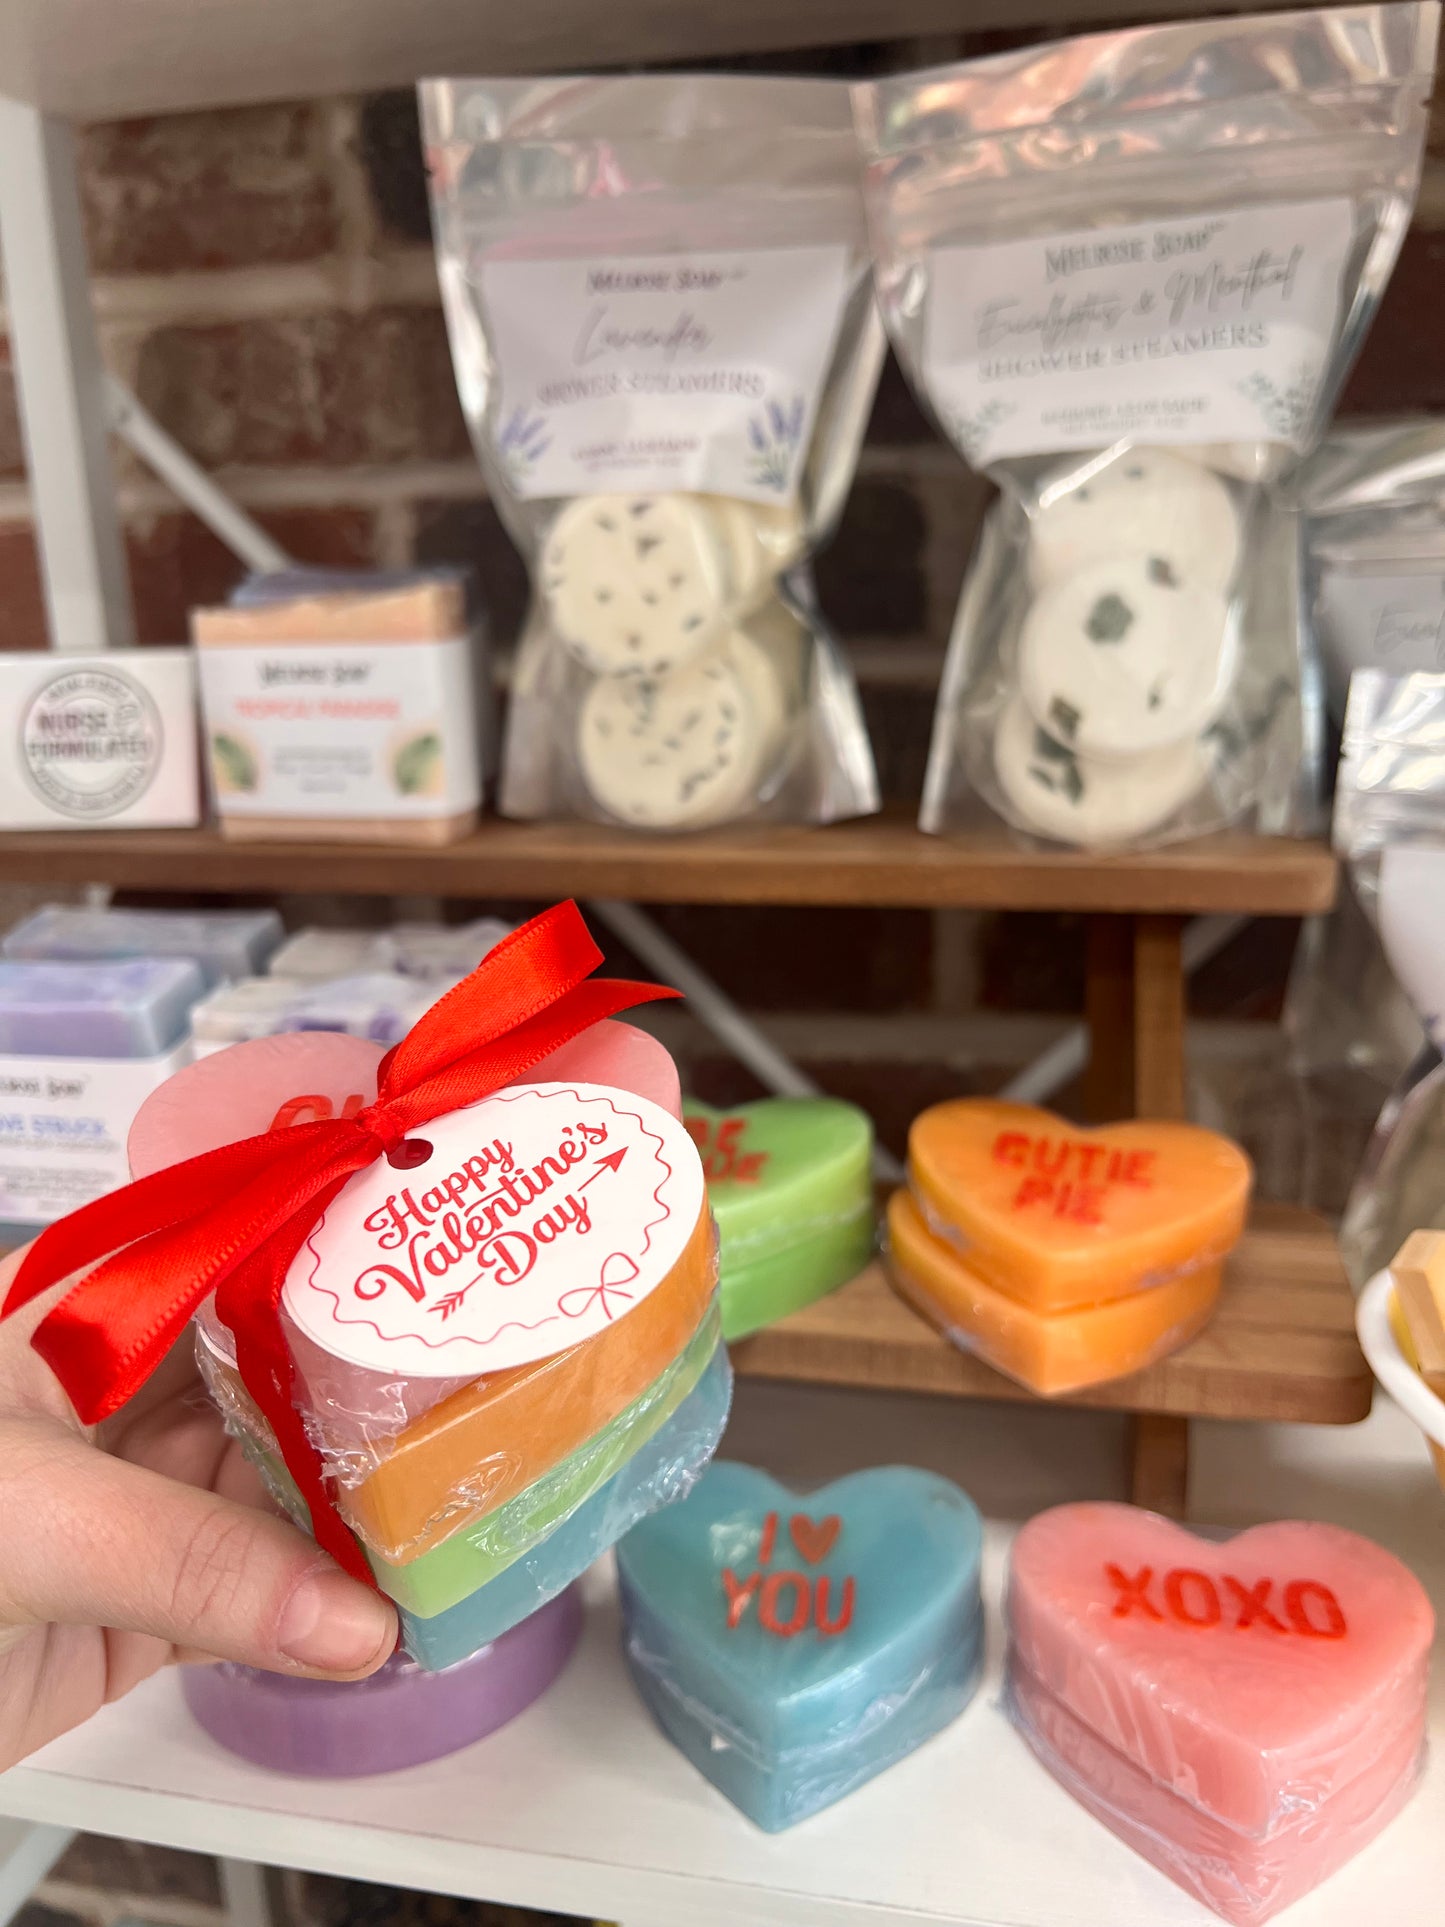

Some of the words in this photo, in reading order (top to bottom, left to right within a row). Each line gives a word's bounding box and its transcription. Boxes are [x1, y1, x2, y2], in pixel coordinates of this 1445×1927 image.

[1152, 230, 1210, 263] SOAP
[1110, 324, 1268, 366] STEAMERS
[38, 711, 107, 731] NURSE
[993, 1132, 1157, 1188] CUTIE
[354, 1121, 609, 1302] Valentine's
[364, 1138, 513, 1250] Happy
[1012, 1176, 1106, 1224] PIE
[477, 1195, 588, 1286] Day
[758, 1511, 778, 1565] I
[721, 1570, 855, 1639] YOU
[1104, 1561, 1348, 1640] XOXO
